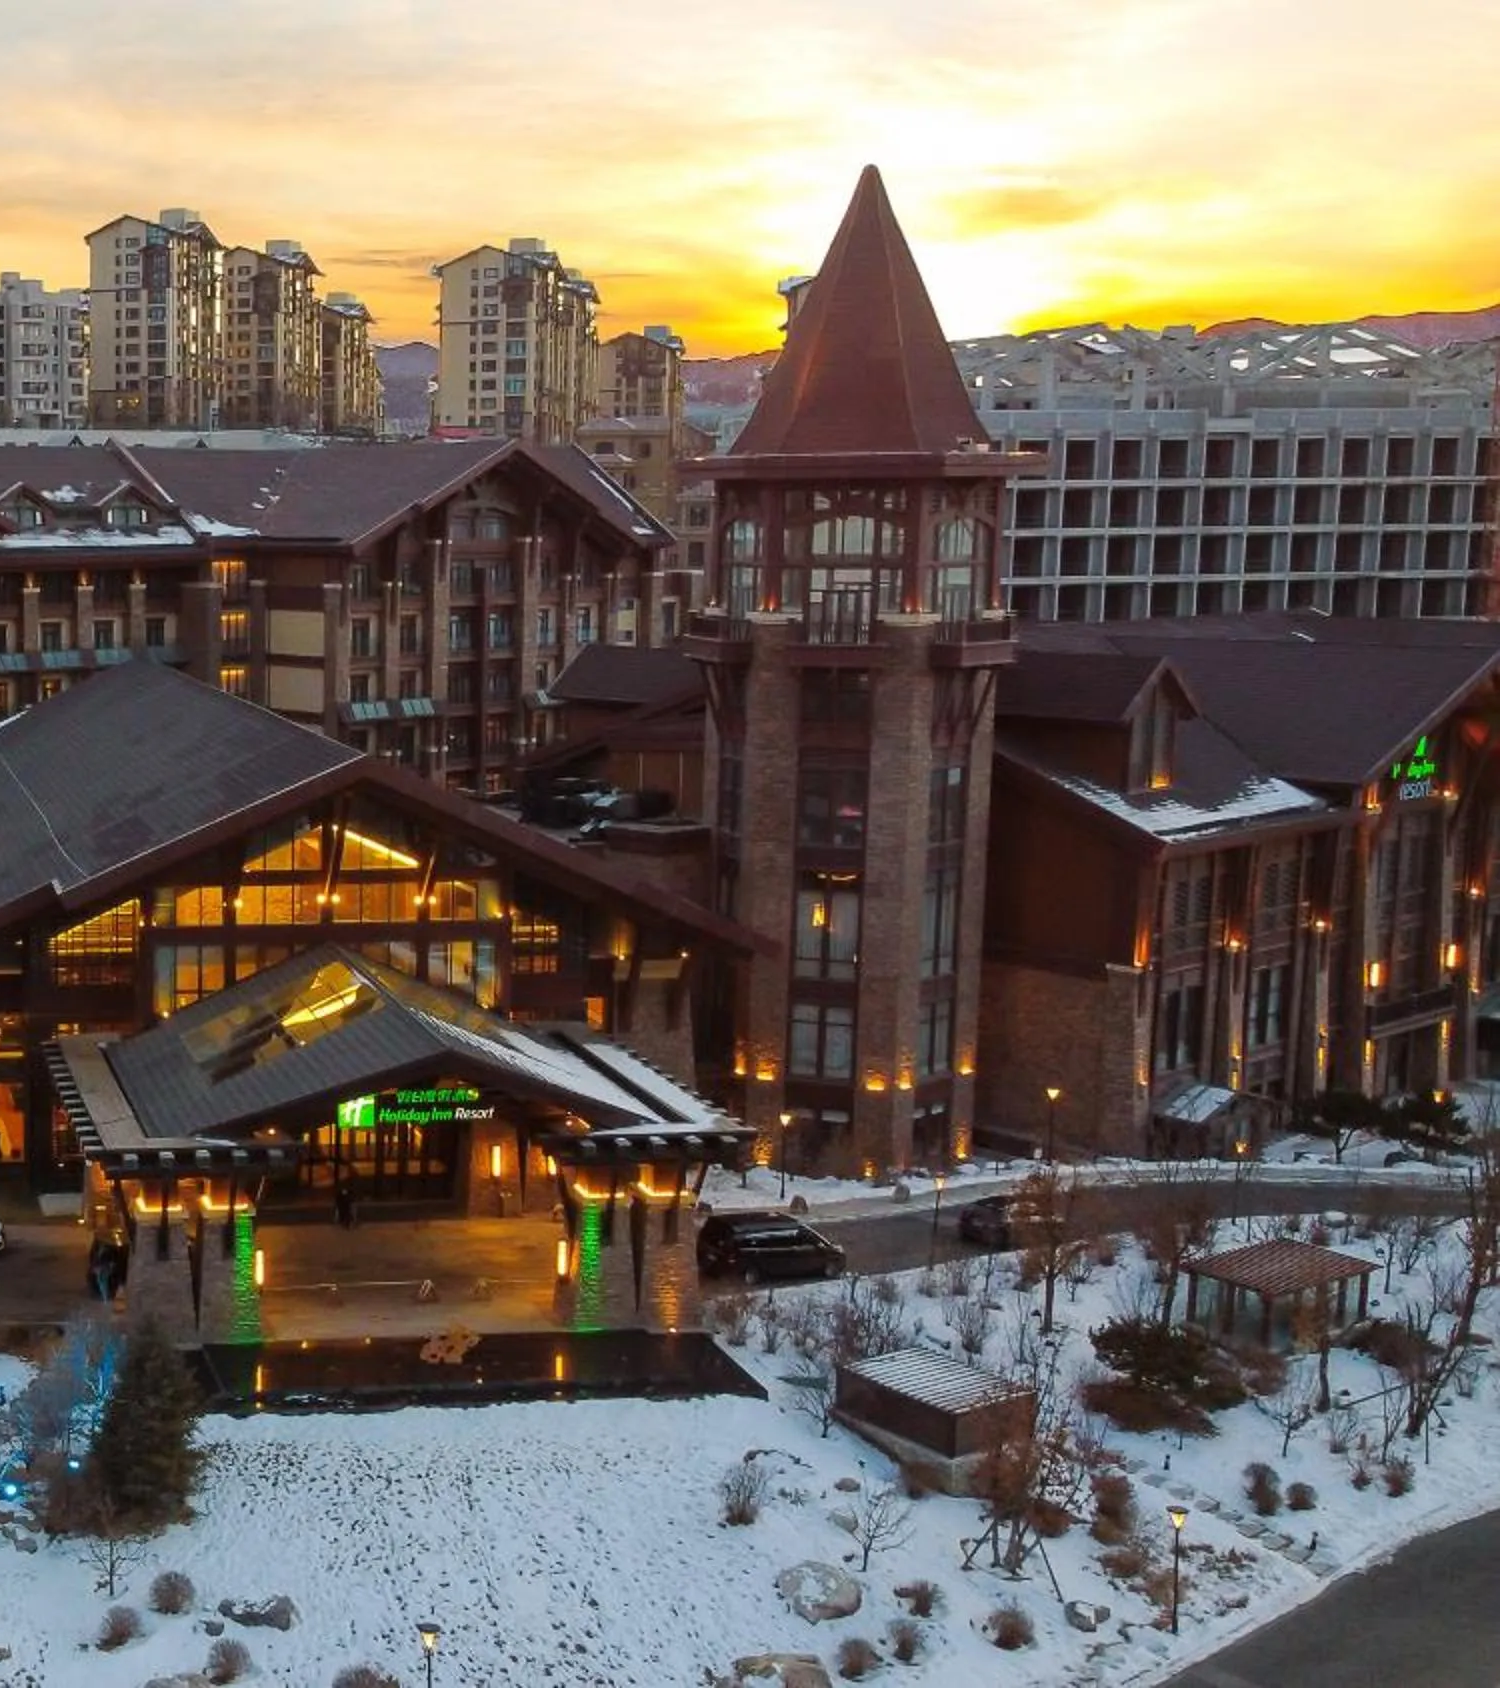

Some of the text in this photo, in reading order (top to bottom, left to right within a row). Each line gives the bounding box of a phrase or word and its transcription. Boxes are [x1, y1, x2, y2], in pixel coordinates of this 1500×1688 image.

[380, 1106, 494, 1123] Holiday Inn Resort
